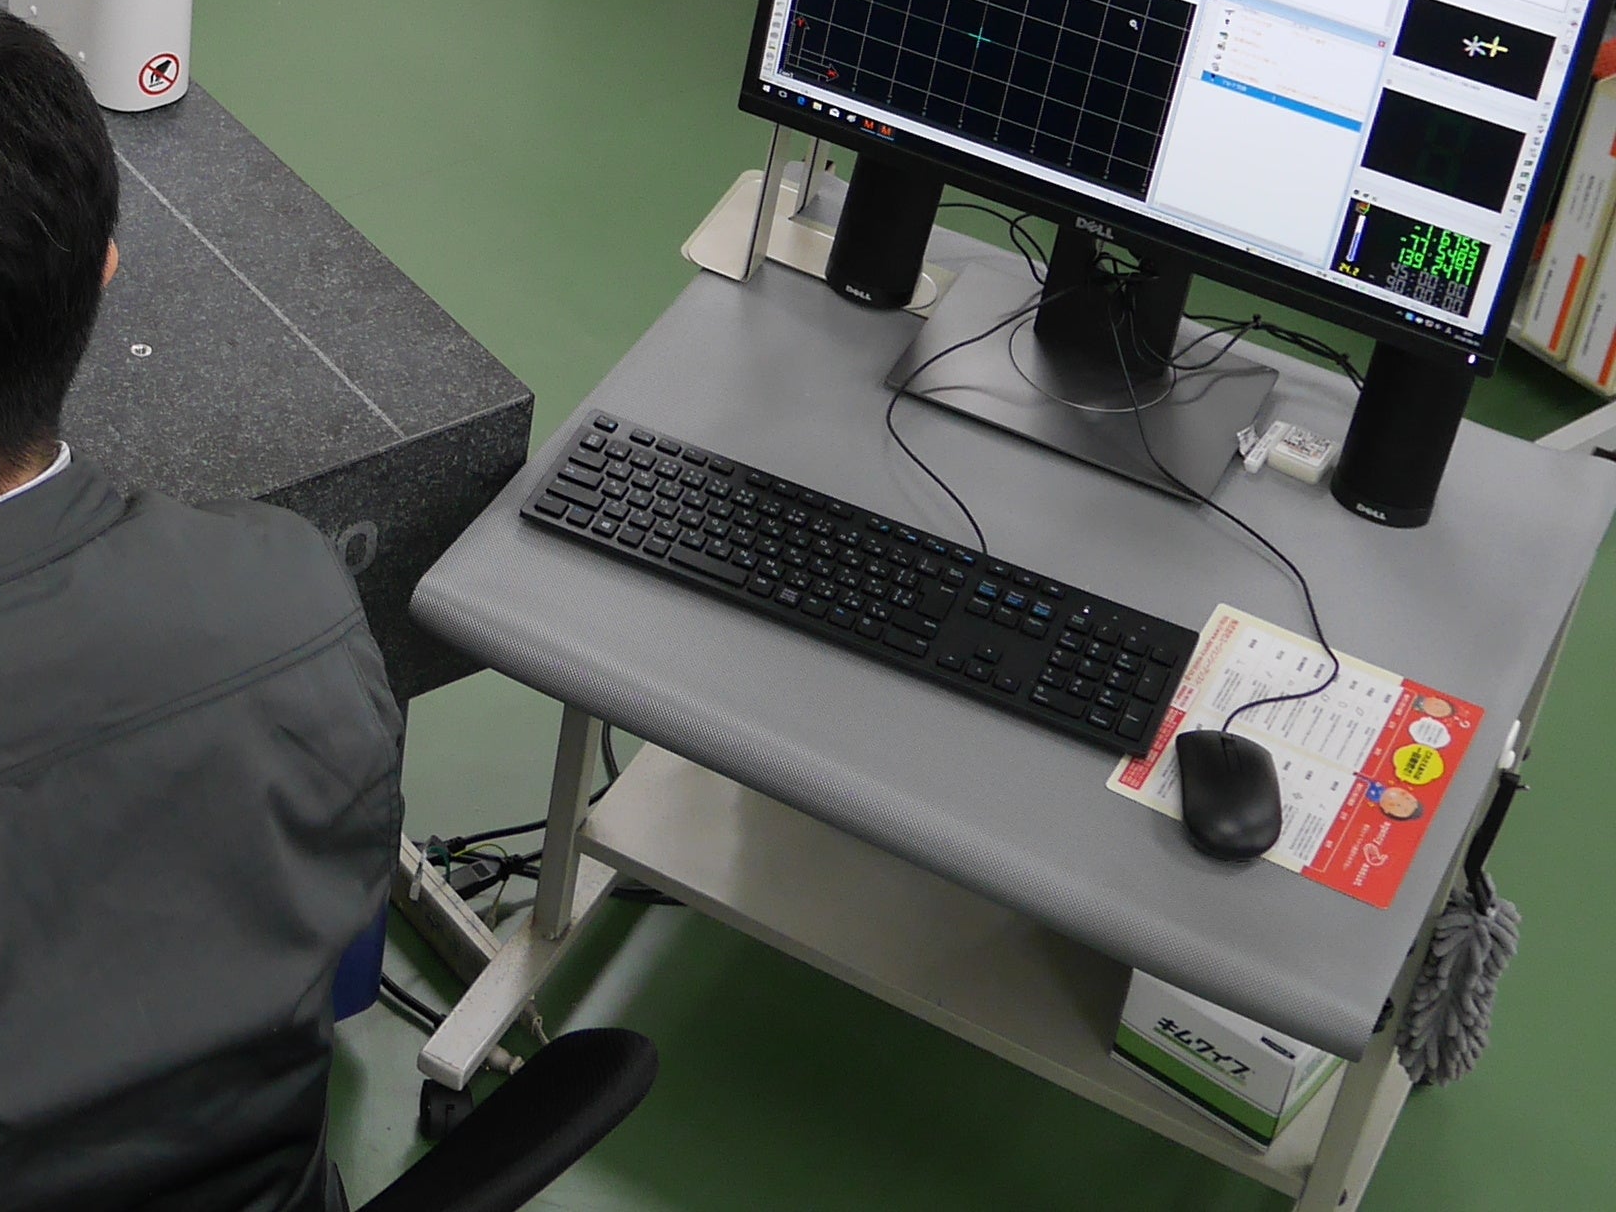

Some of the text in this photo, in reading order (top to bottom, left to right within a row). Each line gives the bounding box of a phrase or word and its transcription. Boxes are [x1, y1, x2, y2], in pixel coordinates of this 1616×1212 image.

[1075, 216, 1114, 240] DELL
[1414, 224, 1481, 255] -1.6755
[1398, 247, 1473, 286] 139.2471
[1400, 233, 1478, 271] -77.5483
[845, 284, 872, 301] DELL
[1391, 262, 1468, 299] 45:00:00
[1356, 503, 1386, 520] DELL
